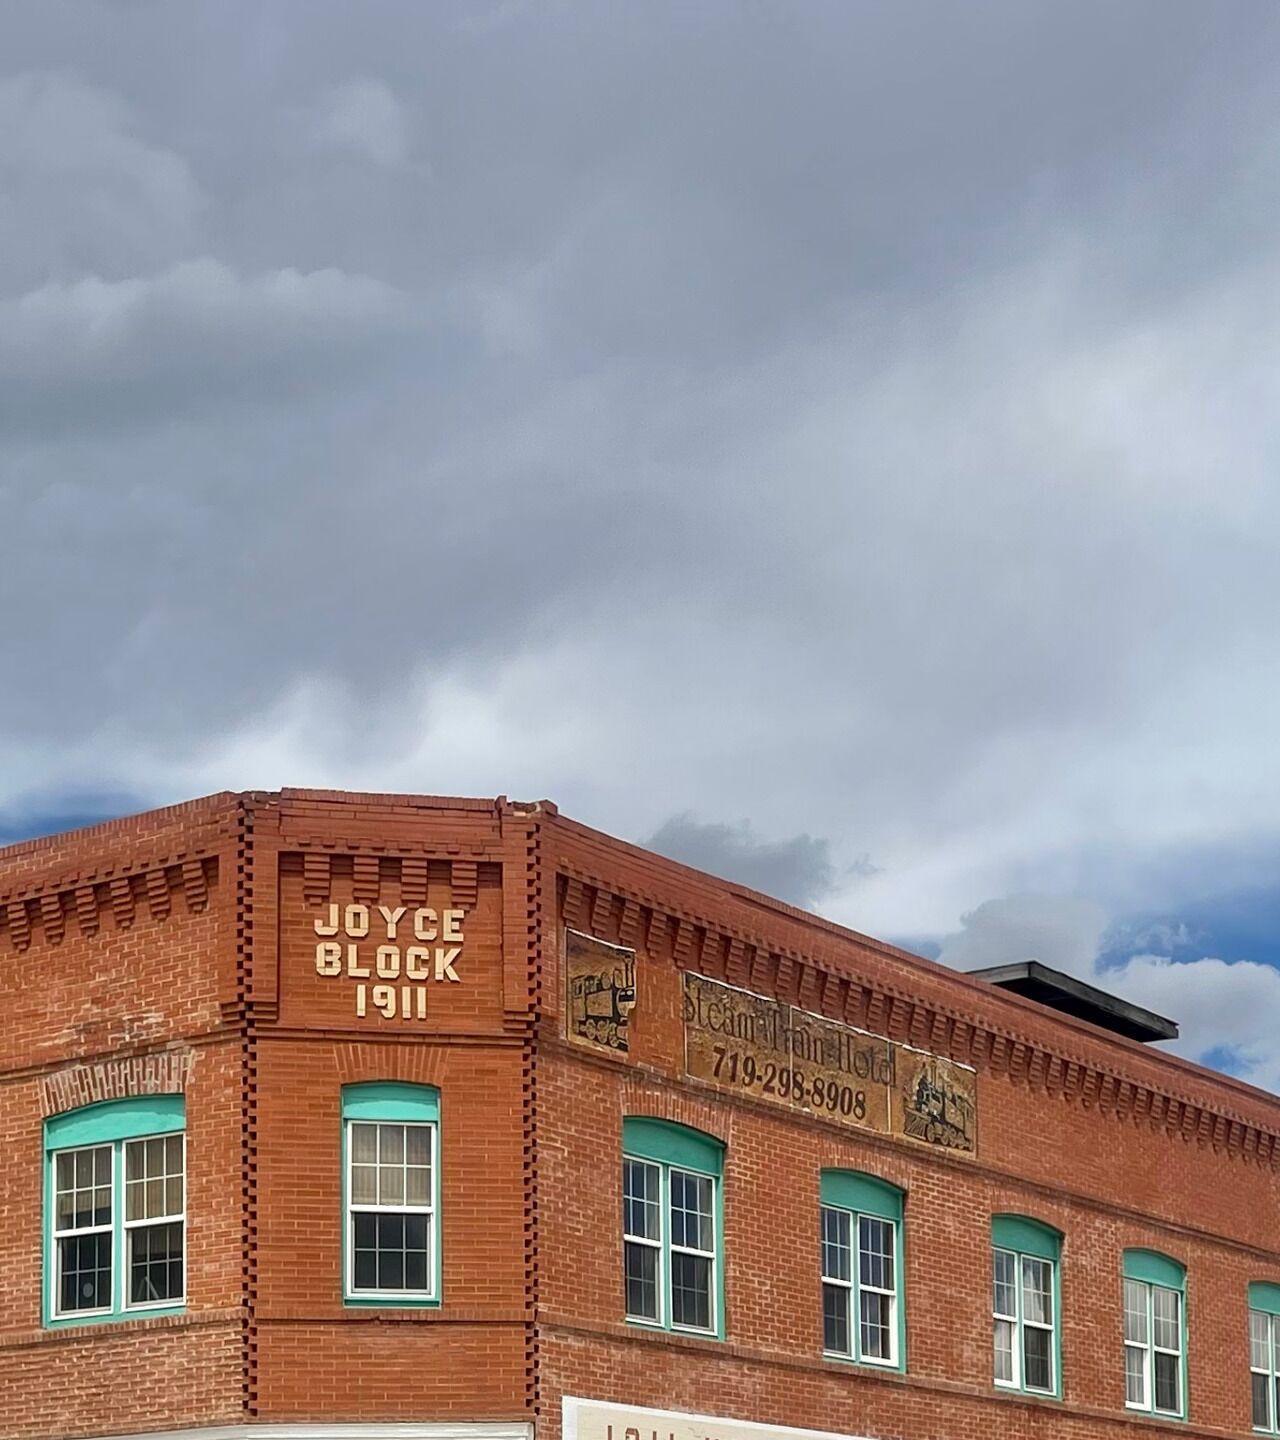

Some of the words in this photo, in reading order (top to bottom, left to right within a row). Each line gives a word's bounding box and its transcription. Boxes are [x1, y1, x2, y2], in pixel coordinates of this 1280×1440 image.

[313, 903, 465, 942] JOYCE
[315, 941, 463, 983] BLOCK
[356, 984, 427, 1019] 1911
[683, 987, 757, 1043] Steam
[763, 1005, 826, 1066] Train
[835, 1029, 897, 1087] Hotel
[712, 1045, 867, 1120] 719-298-8908
